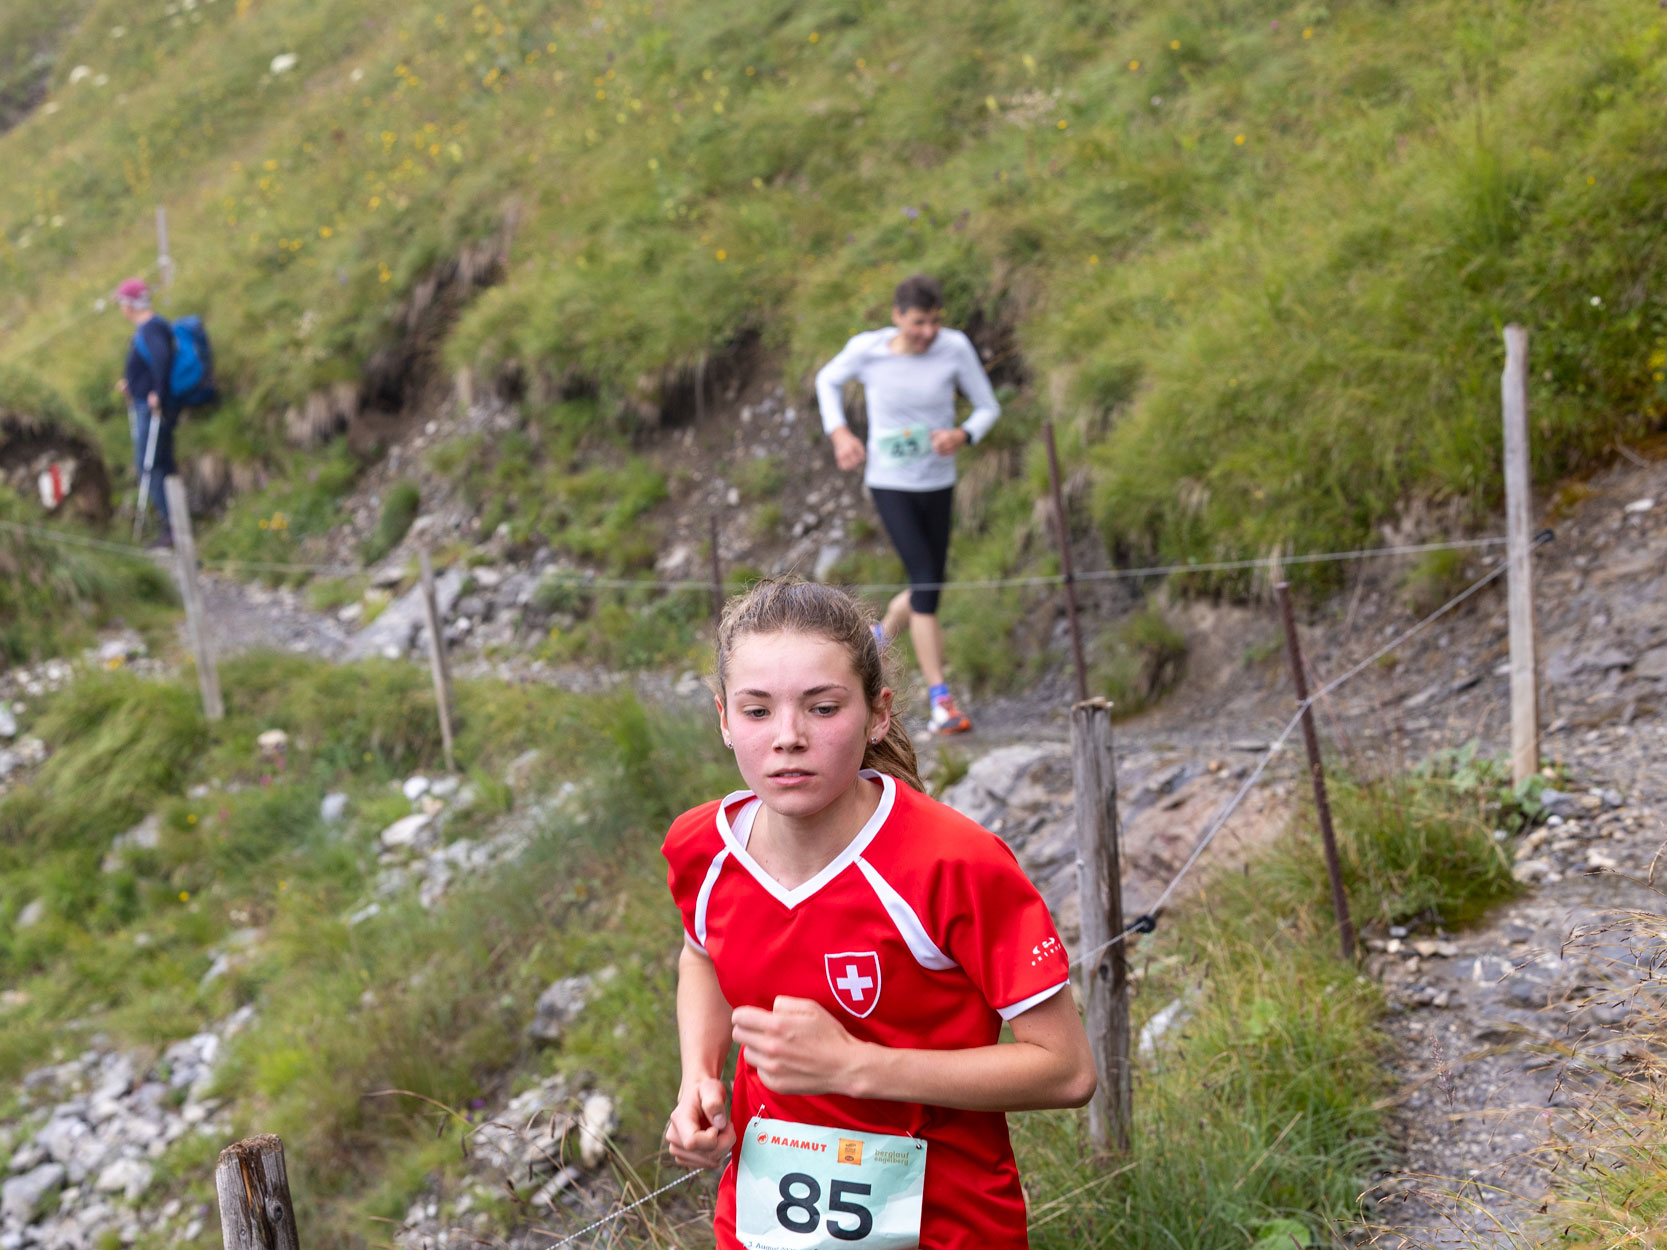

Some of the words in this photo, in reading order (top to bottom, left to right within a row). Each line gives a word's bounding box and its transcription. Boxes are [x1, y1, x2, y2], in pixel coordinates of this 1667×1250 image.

[771, 1135, 827, 1152] MAMMUT
[874, 1149, 909, 1160] berglauf
[776, 1172, 873, 1241] 85
